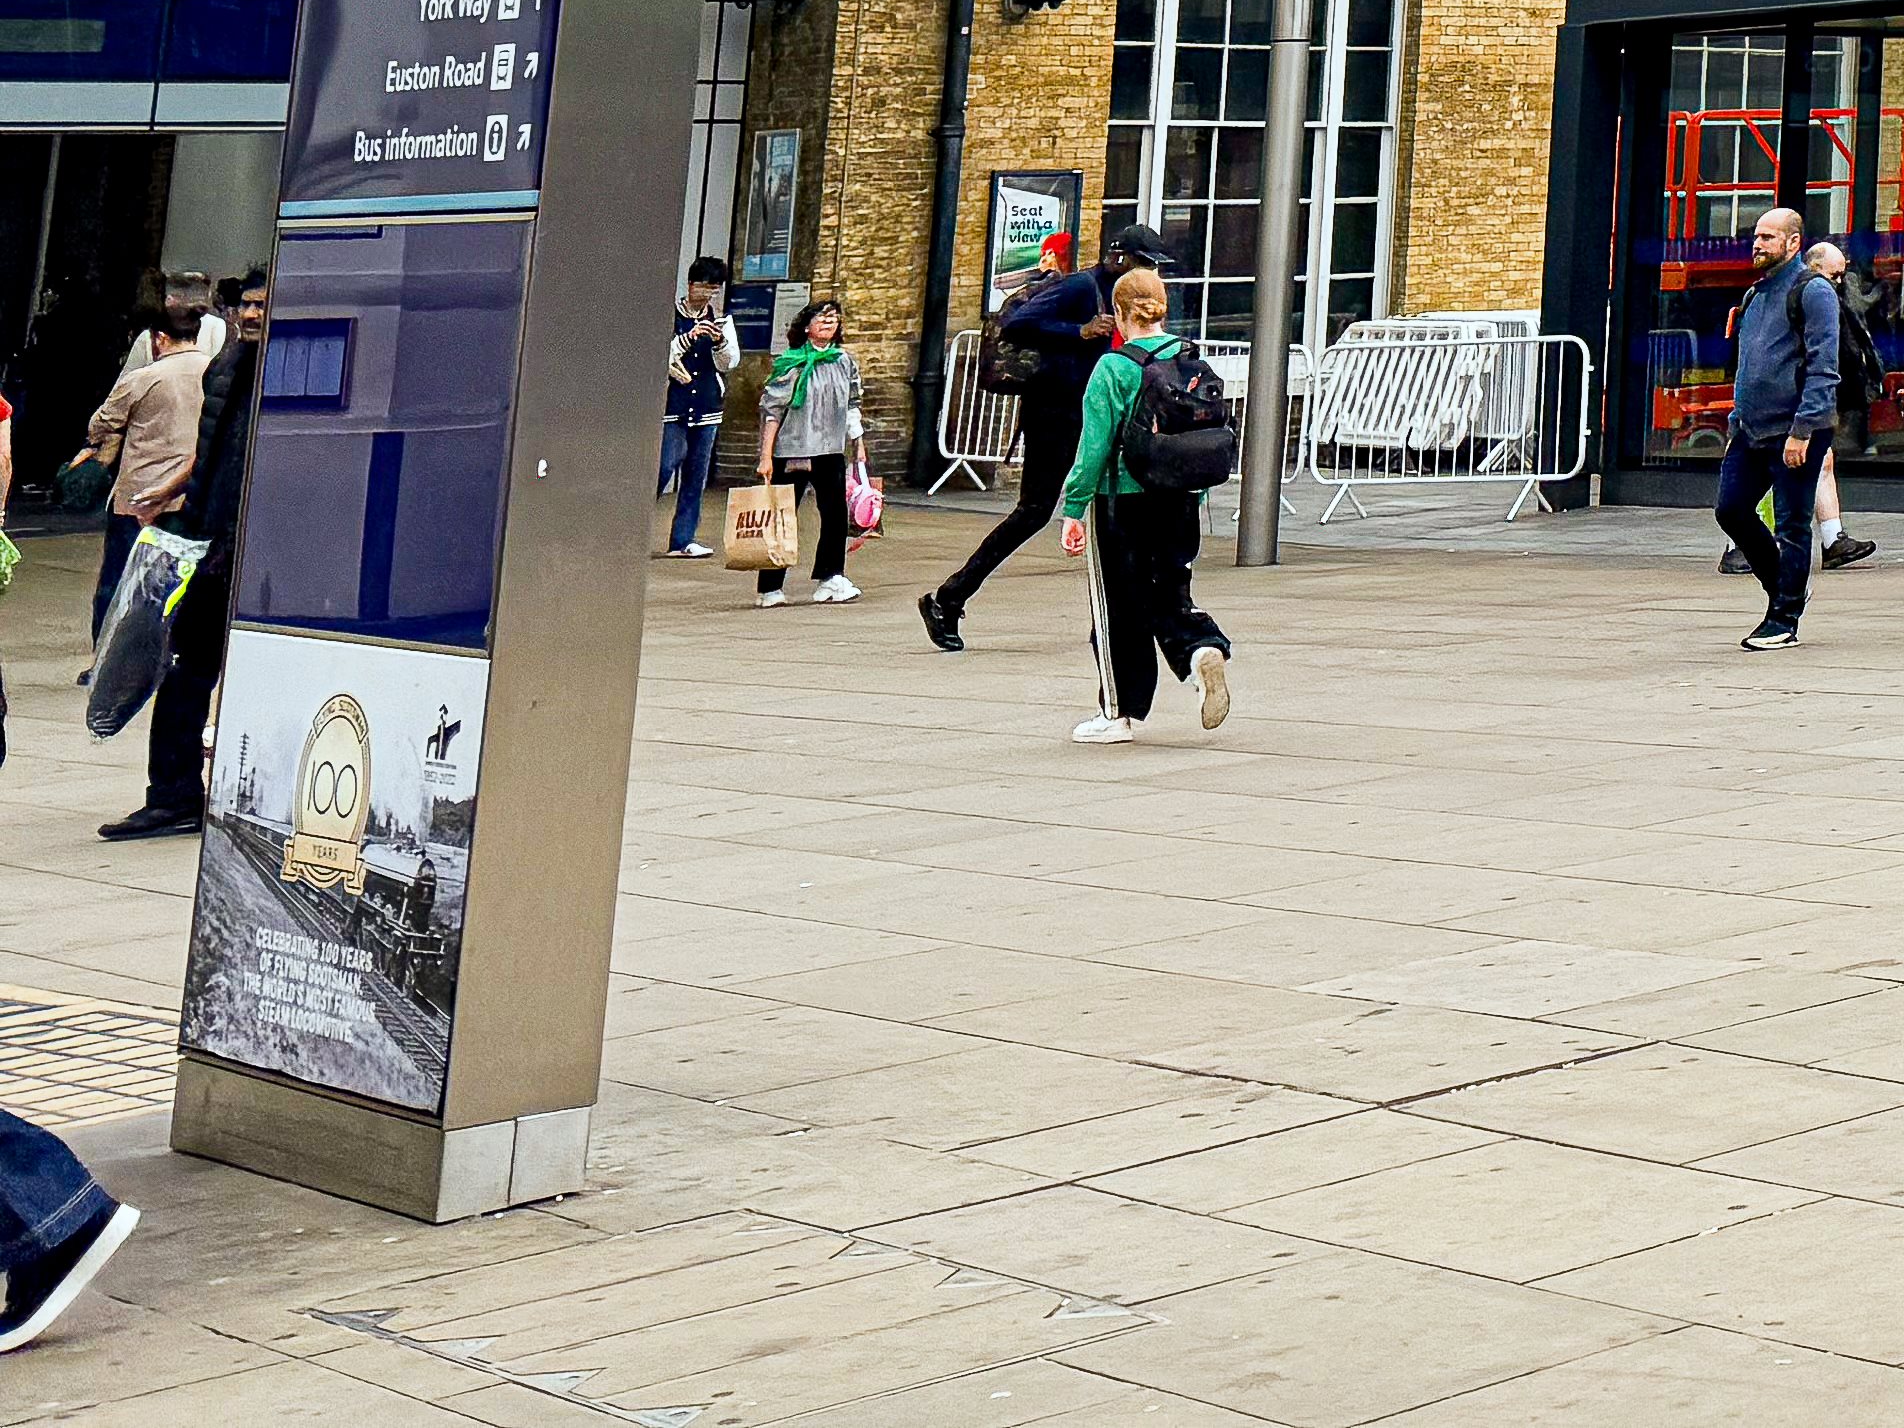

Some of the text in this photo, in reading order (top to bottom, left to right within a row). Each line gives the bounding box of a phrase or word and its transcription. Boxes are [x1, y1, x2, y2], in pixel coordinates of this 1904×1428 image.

[385, 52, 486, 92] Euston Road
[354, 125, 478, 162] Bus information
[1010, 218, 1053, 230] with a
[1011, 205, 1043, 217] Seat
[1009, 231, 1041, 243] view
[308, 760, 357, 818] 100
[312, 845, 338, 861] YEARS
[255, 927, 374, 973] CELEBRATING 100 YEARS
[259, 951, 273, 973] OF
[274, 954, 307, 982] FLYING
[243, 971, 262, 995] THE
[257, 1000, 290, 1026] STEAM
